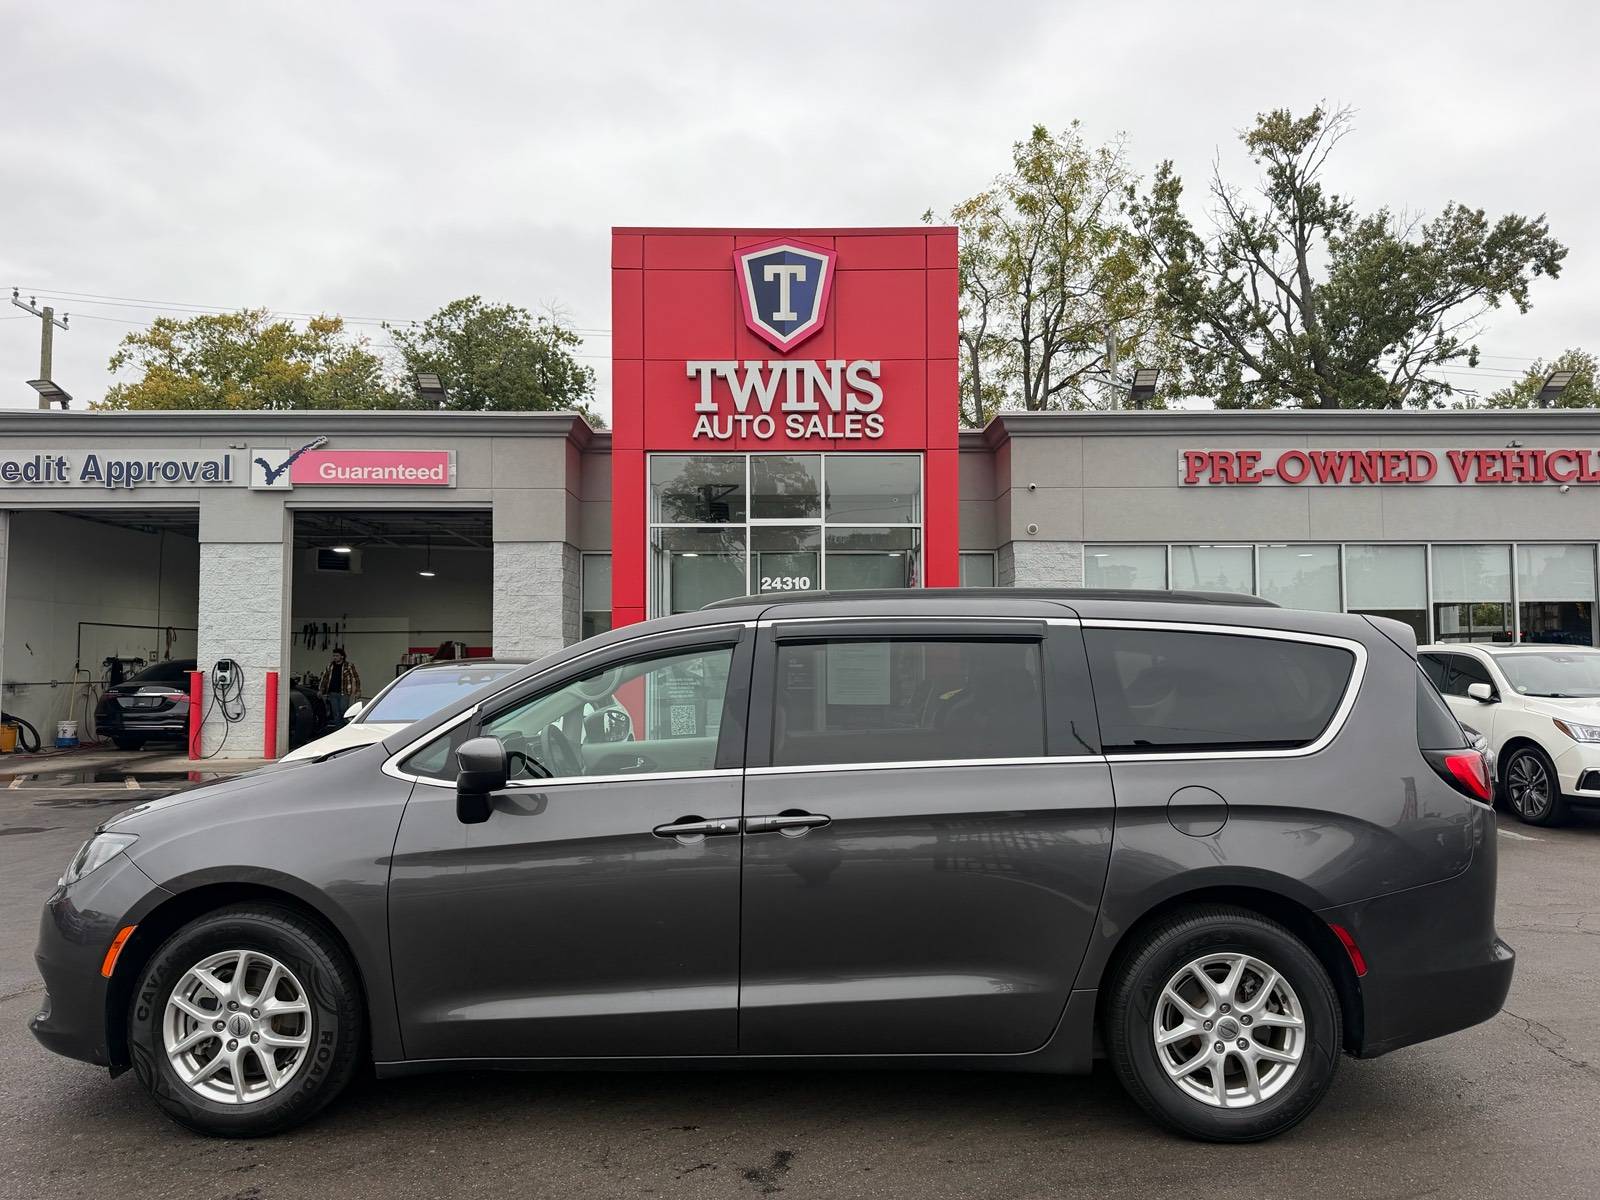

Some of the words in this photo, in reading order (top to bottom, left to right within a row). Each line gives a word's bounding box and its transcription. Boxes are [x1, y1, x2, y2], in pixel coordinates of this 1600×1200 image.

[764, 265, 806, 320] T
[687, 360, 883, 413] TWINS
[693, 415, 775, 438] AUTO
[785, 414, 884, 438] SALES
[0, 455, 67, 482] edit
[79, 454, 231, 488] Approval
[319, 463, 443, 480] Guaranteed
[1184, 450, 1438, 484] PRE-OWNED
[1446, 449, 1600, 484] VEHICL
[761, 576, 810, 590] 24310
